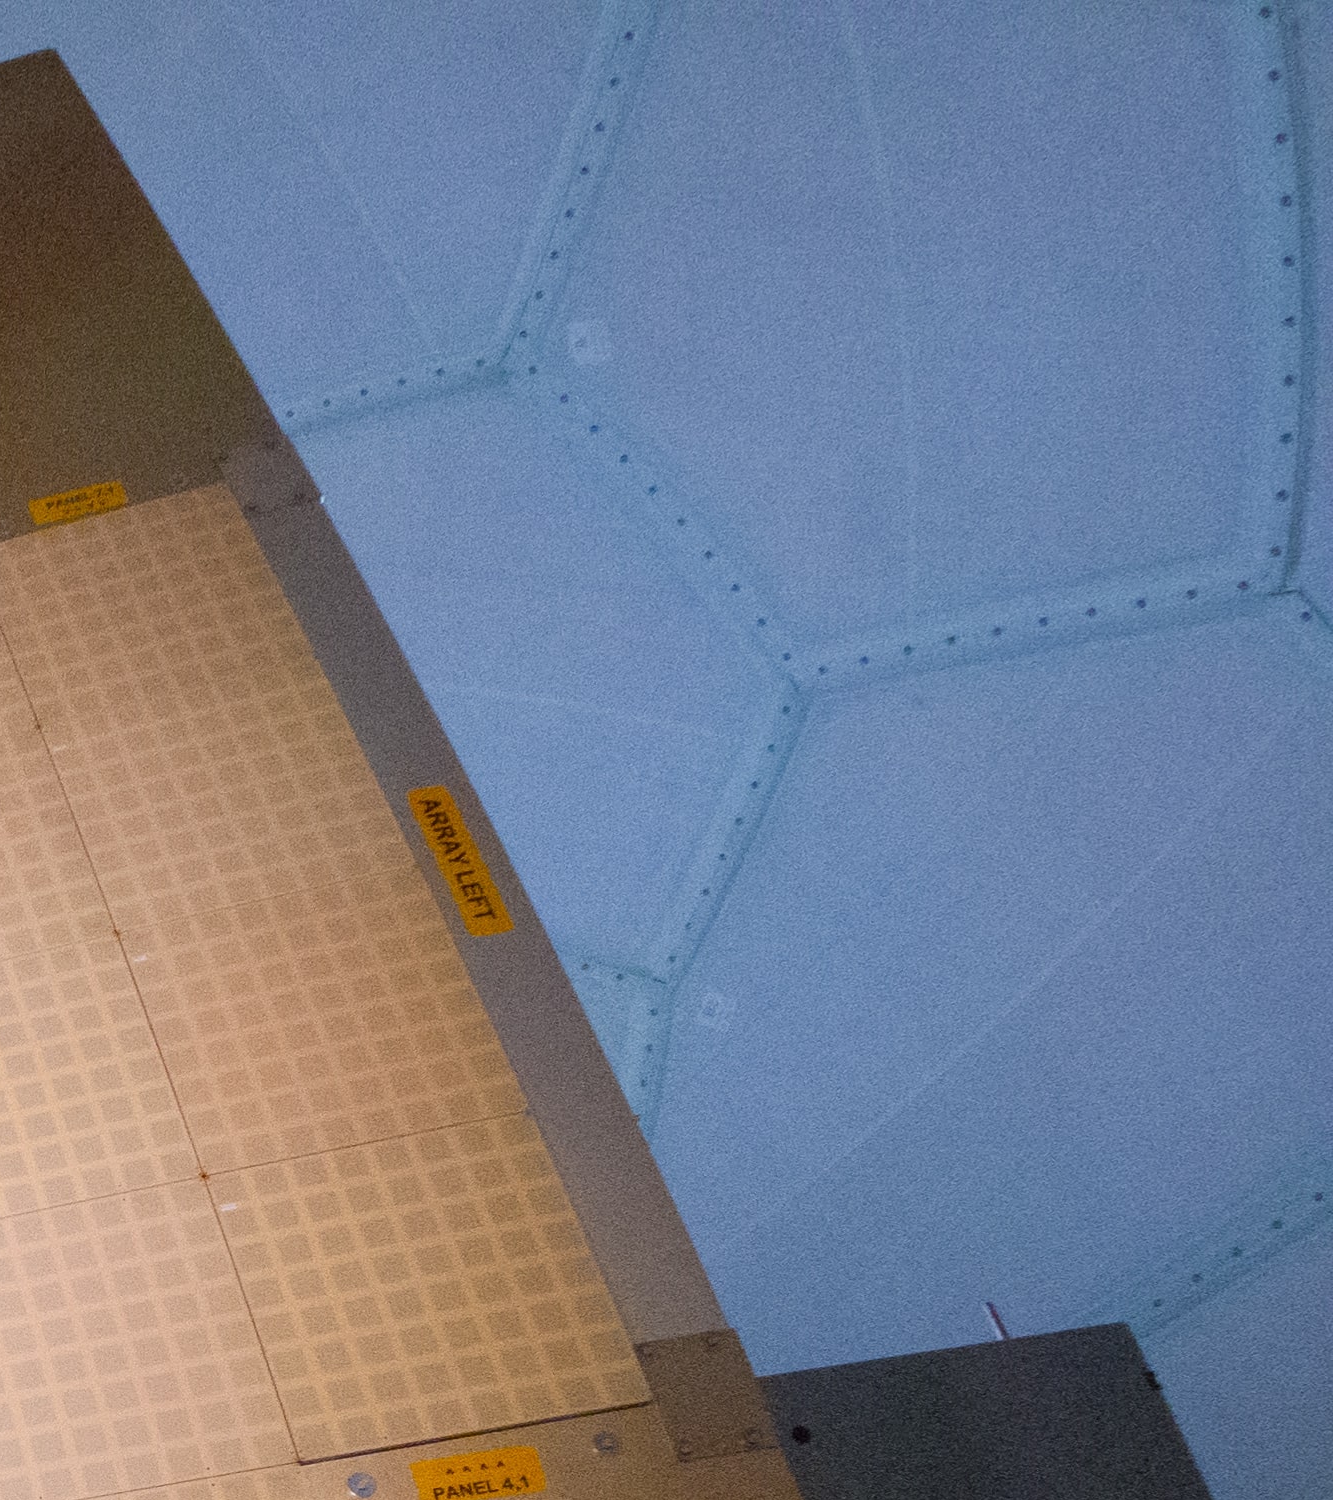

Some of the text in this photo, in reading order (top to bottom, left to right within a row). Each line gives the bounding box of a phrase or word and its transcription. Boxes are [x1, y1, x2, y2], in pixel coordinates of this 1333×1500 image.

[418, 799, 497, 919] ARRAY LEFT
[433, 1474, 530, 1500] PANEL 4,1
